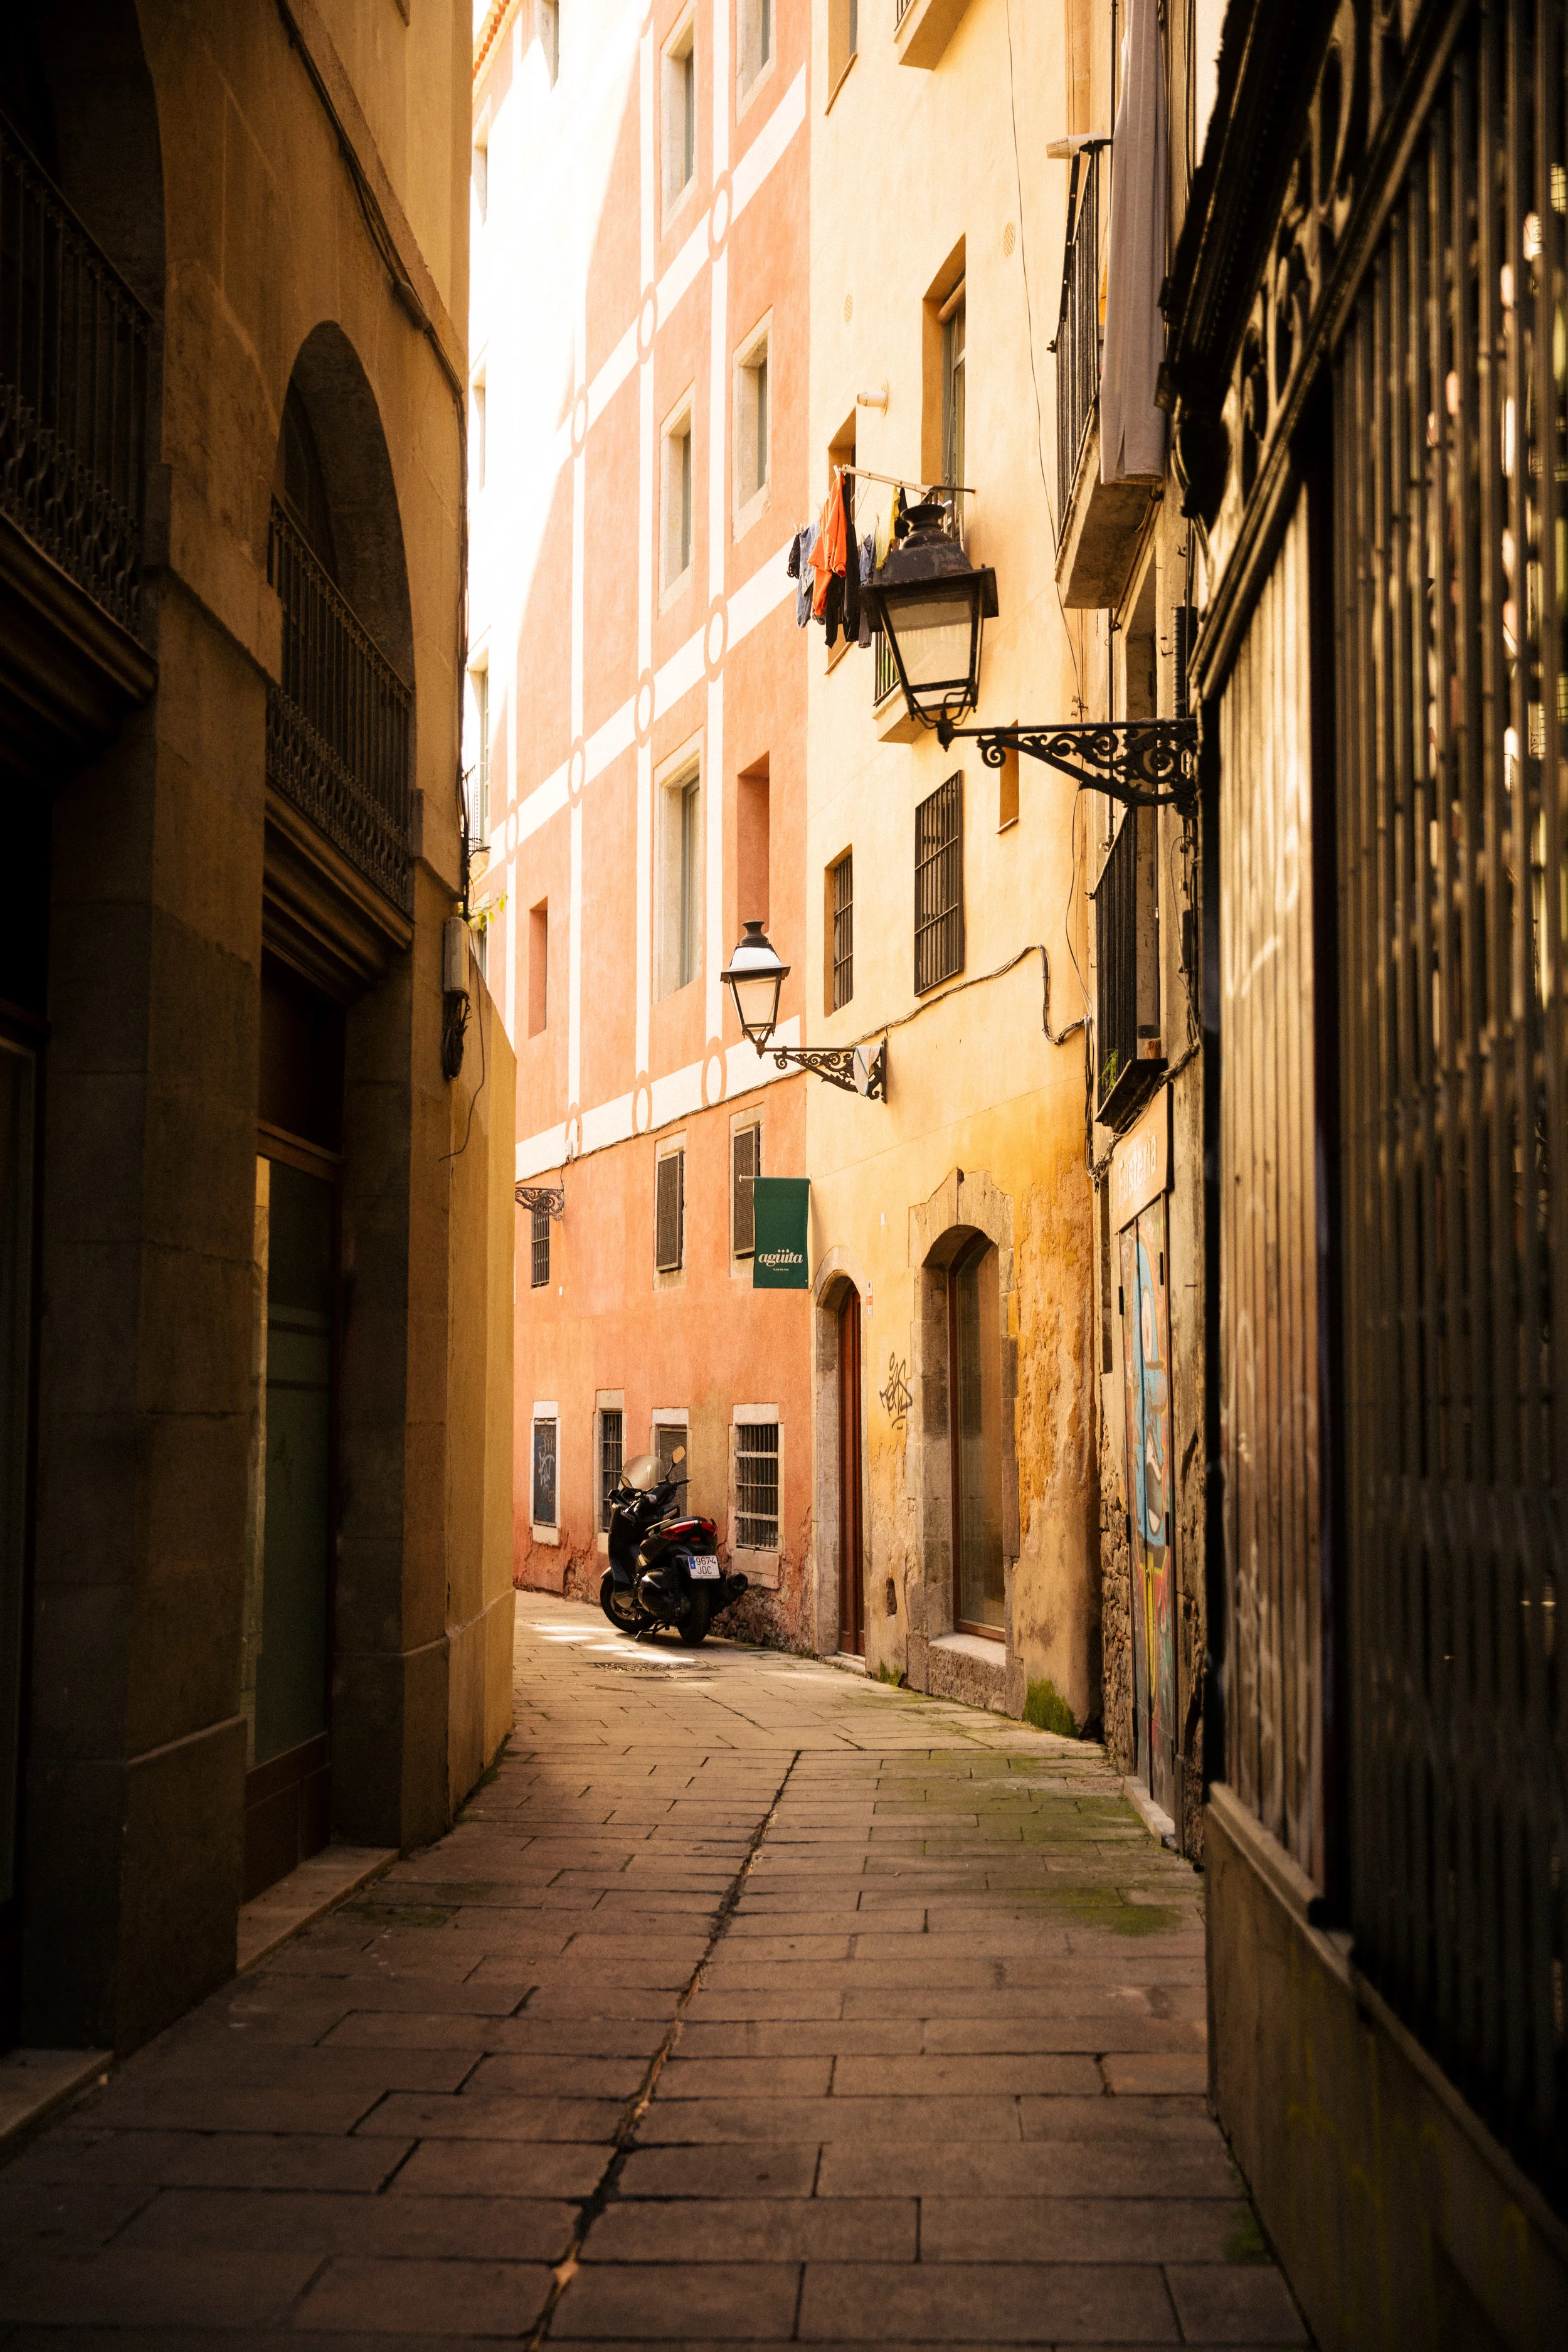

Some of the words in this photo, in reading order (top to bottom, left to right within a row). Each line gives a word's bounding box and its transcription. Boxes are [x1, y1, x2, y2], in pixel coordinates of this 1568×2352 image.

[1118, 1127, 1157, 1209] Fusteria
[758, 1249, 803, 1267] agüita
[696, 1557, 716, 1565] 9674
[697, 1565, 712, 1574] JDC
